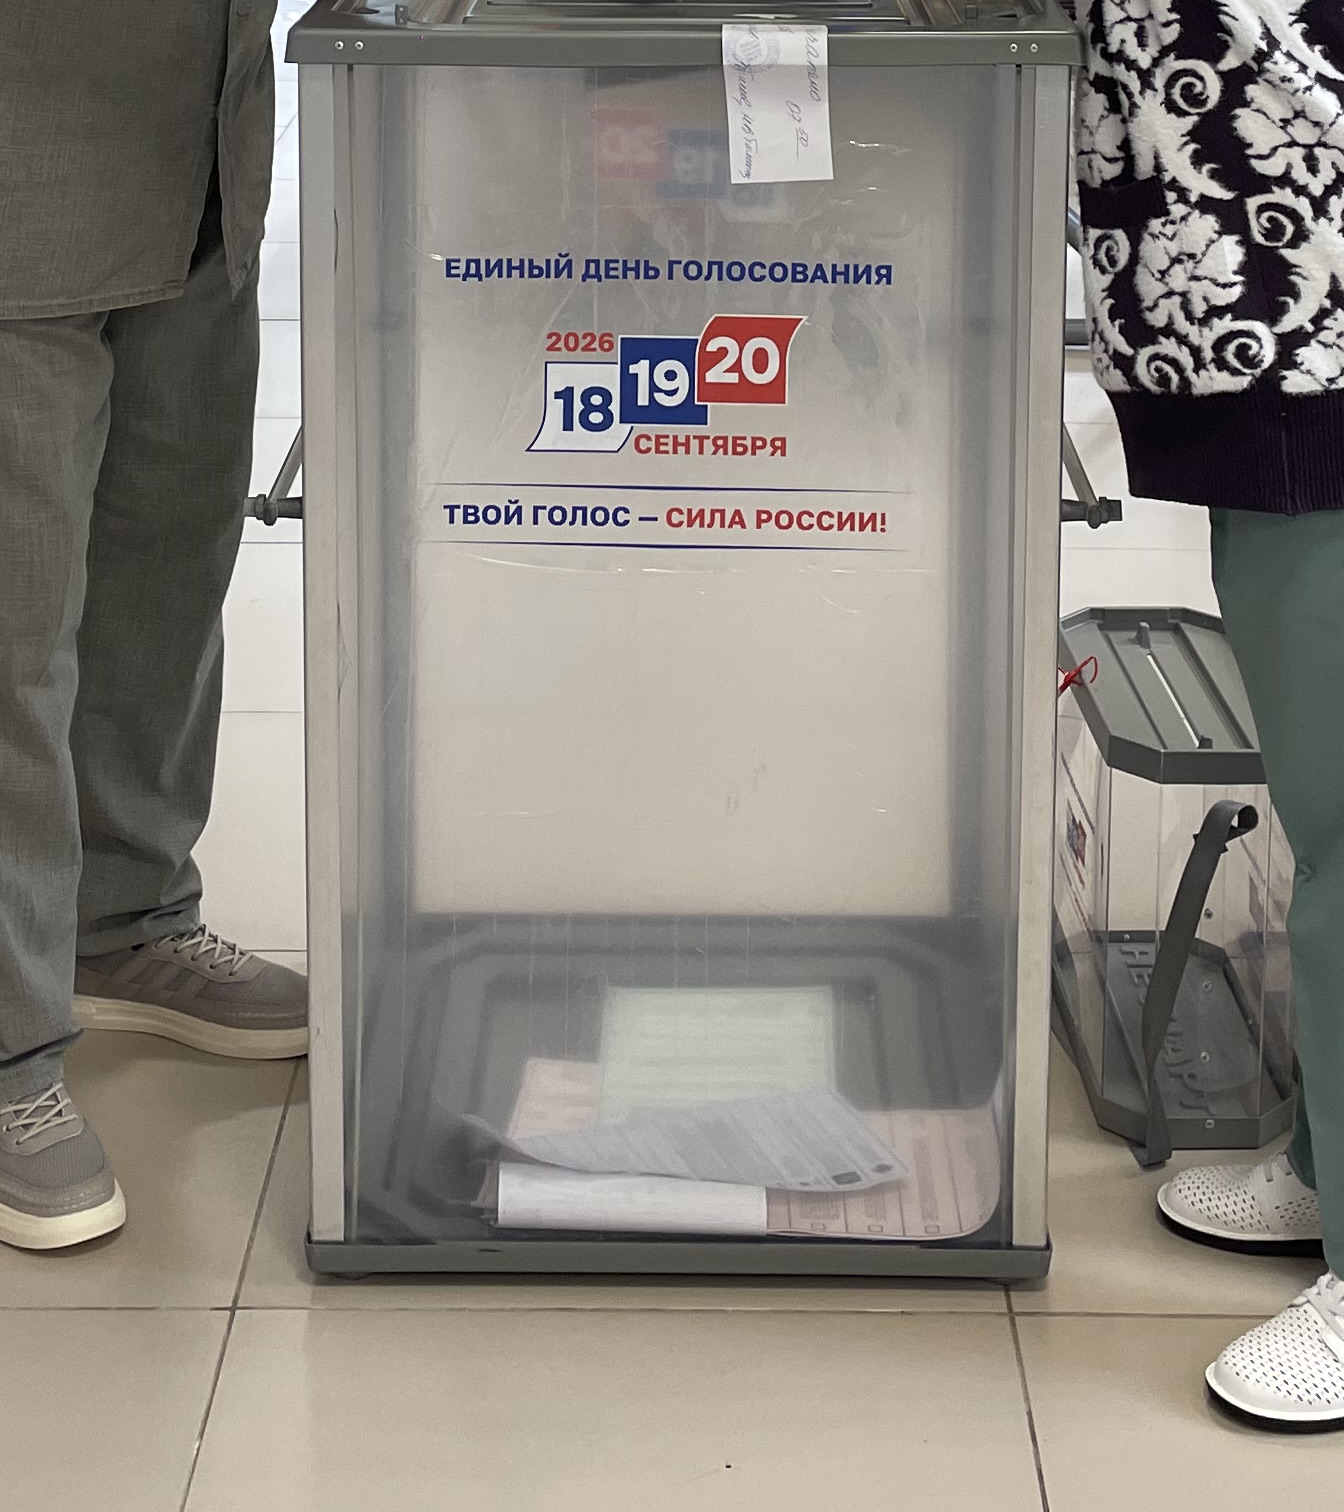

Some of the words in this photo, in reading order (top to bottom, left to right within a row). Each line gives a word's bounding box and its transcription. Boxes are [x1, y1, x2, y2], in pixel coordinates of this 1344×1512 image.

[444, 253, 574, 282] ЕДИНЫЙ
[580, 258, 660, 283] ДЕНЬ
[667, 260, 894, 286] ГОЛОСОВАНИЯ
[545, 331, 615, 353] 2026
[705, 336, 780, 385] 20
[628, 359, 690, 407] 19
[553, 386, 614, 433] 18
[632, 433, 788, 458] СЕНТЯБРЯ
[443, 500, 523, 526] ТВОЙ
[532, 505, 630, 527] ГОЛОС
[665, 506, 747, 531] СИЛА
[754, 507, 887, 533] РОССИИ!
